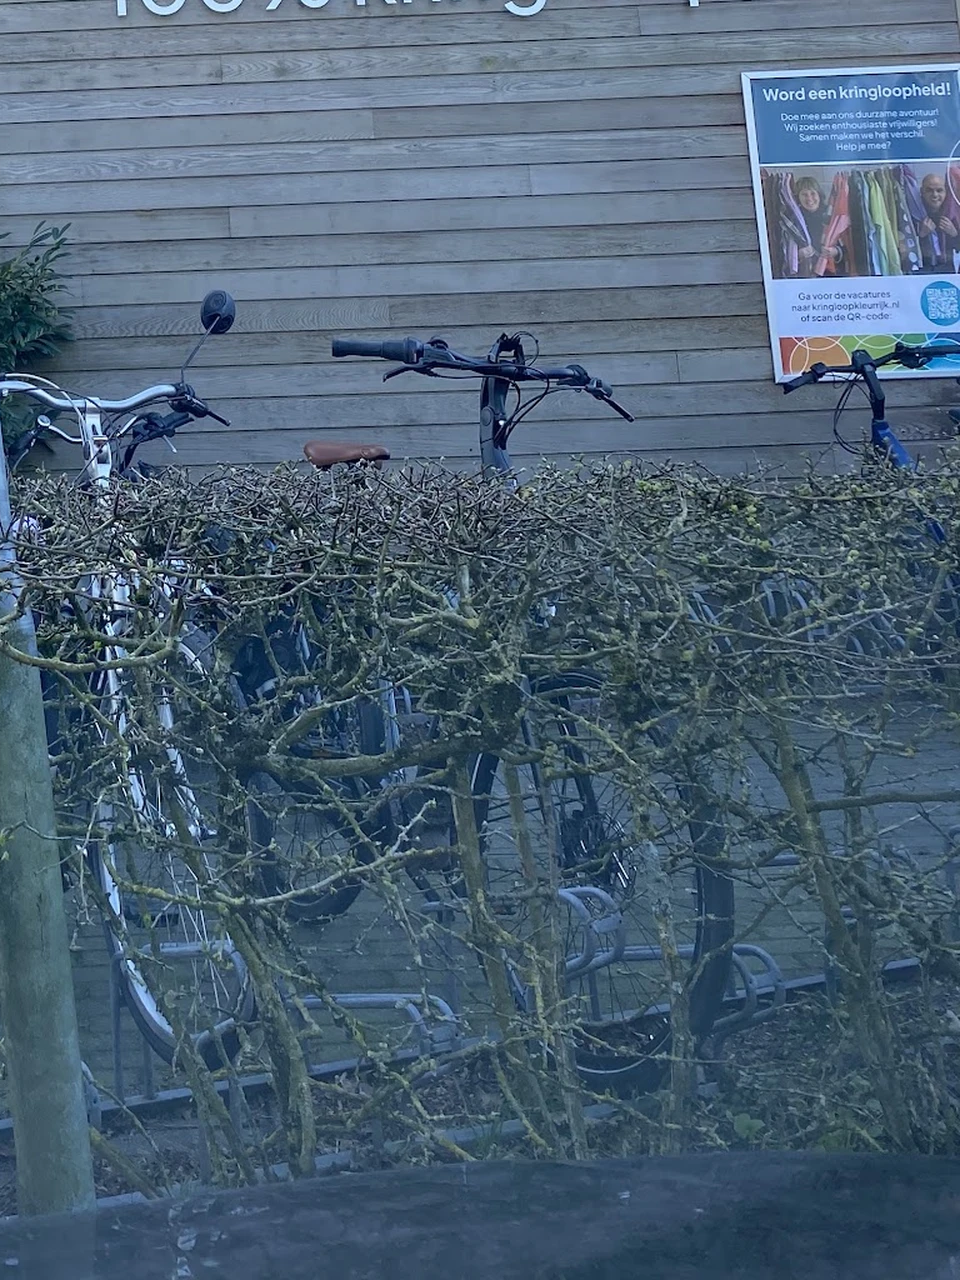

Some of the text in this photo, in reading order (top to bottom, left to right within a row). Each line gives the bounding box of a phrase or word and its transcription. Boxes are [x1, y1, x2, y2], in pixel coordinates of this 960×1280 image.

[763, 83, 951, 101] Word een kringloopheld!
[781, 113, 799, 121] Doe
[856, 110, 897, 119] duurzame
[784, 123, 798, 133] Wij
[799, 122, 830, 131] zoeken
[832, 121, 888, 130] enthousiaste
[800, 133, 829, 141] Samen
[831, 132, 860, 140] maken
[875, 131, 889, 139] het
[836, 141, 891, 152] Help je mee?
[798, 293, 811, 301] Ga
[835, 292, 846, 300] de
[847, 291, 891, 299] vacatures
[792, 301, 900, 312] naar kringloopkleurrijk.nl
[835, 313, 845, 321] de
[847, 312, 892, 321] QR-code:
